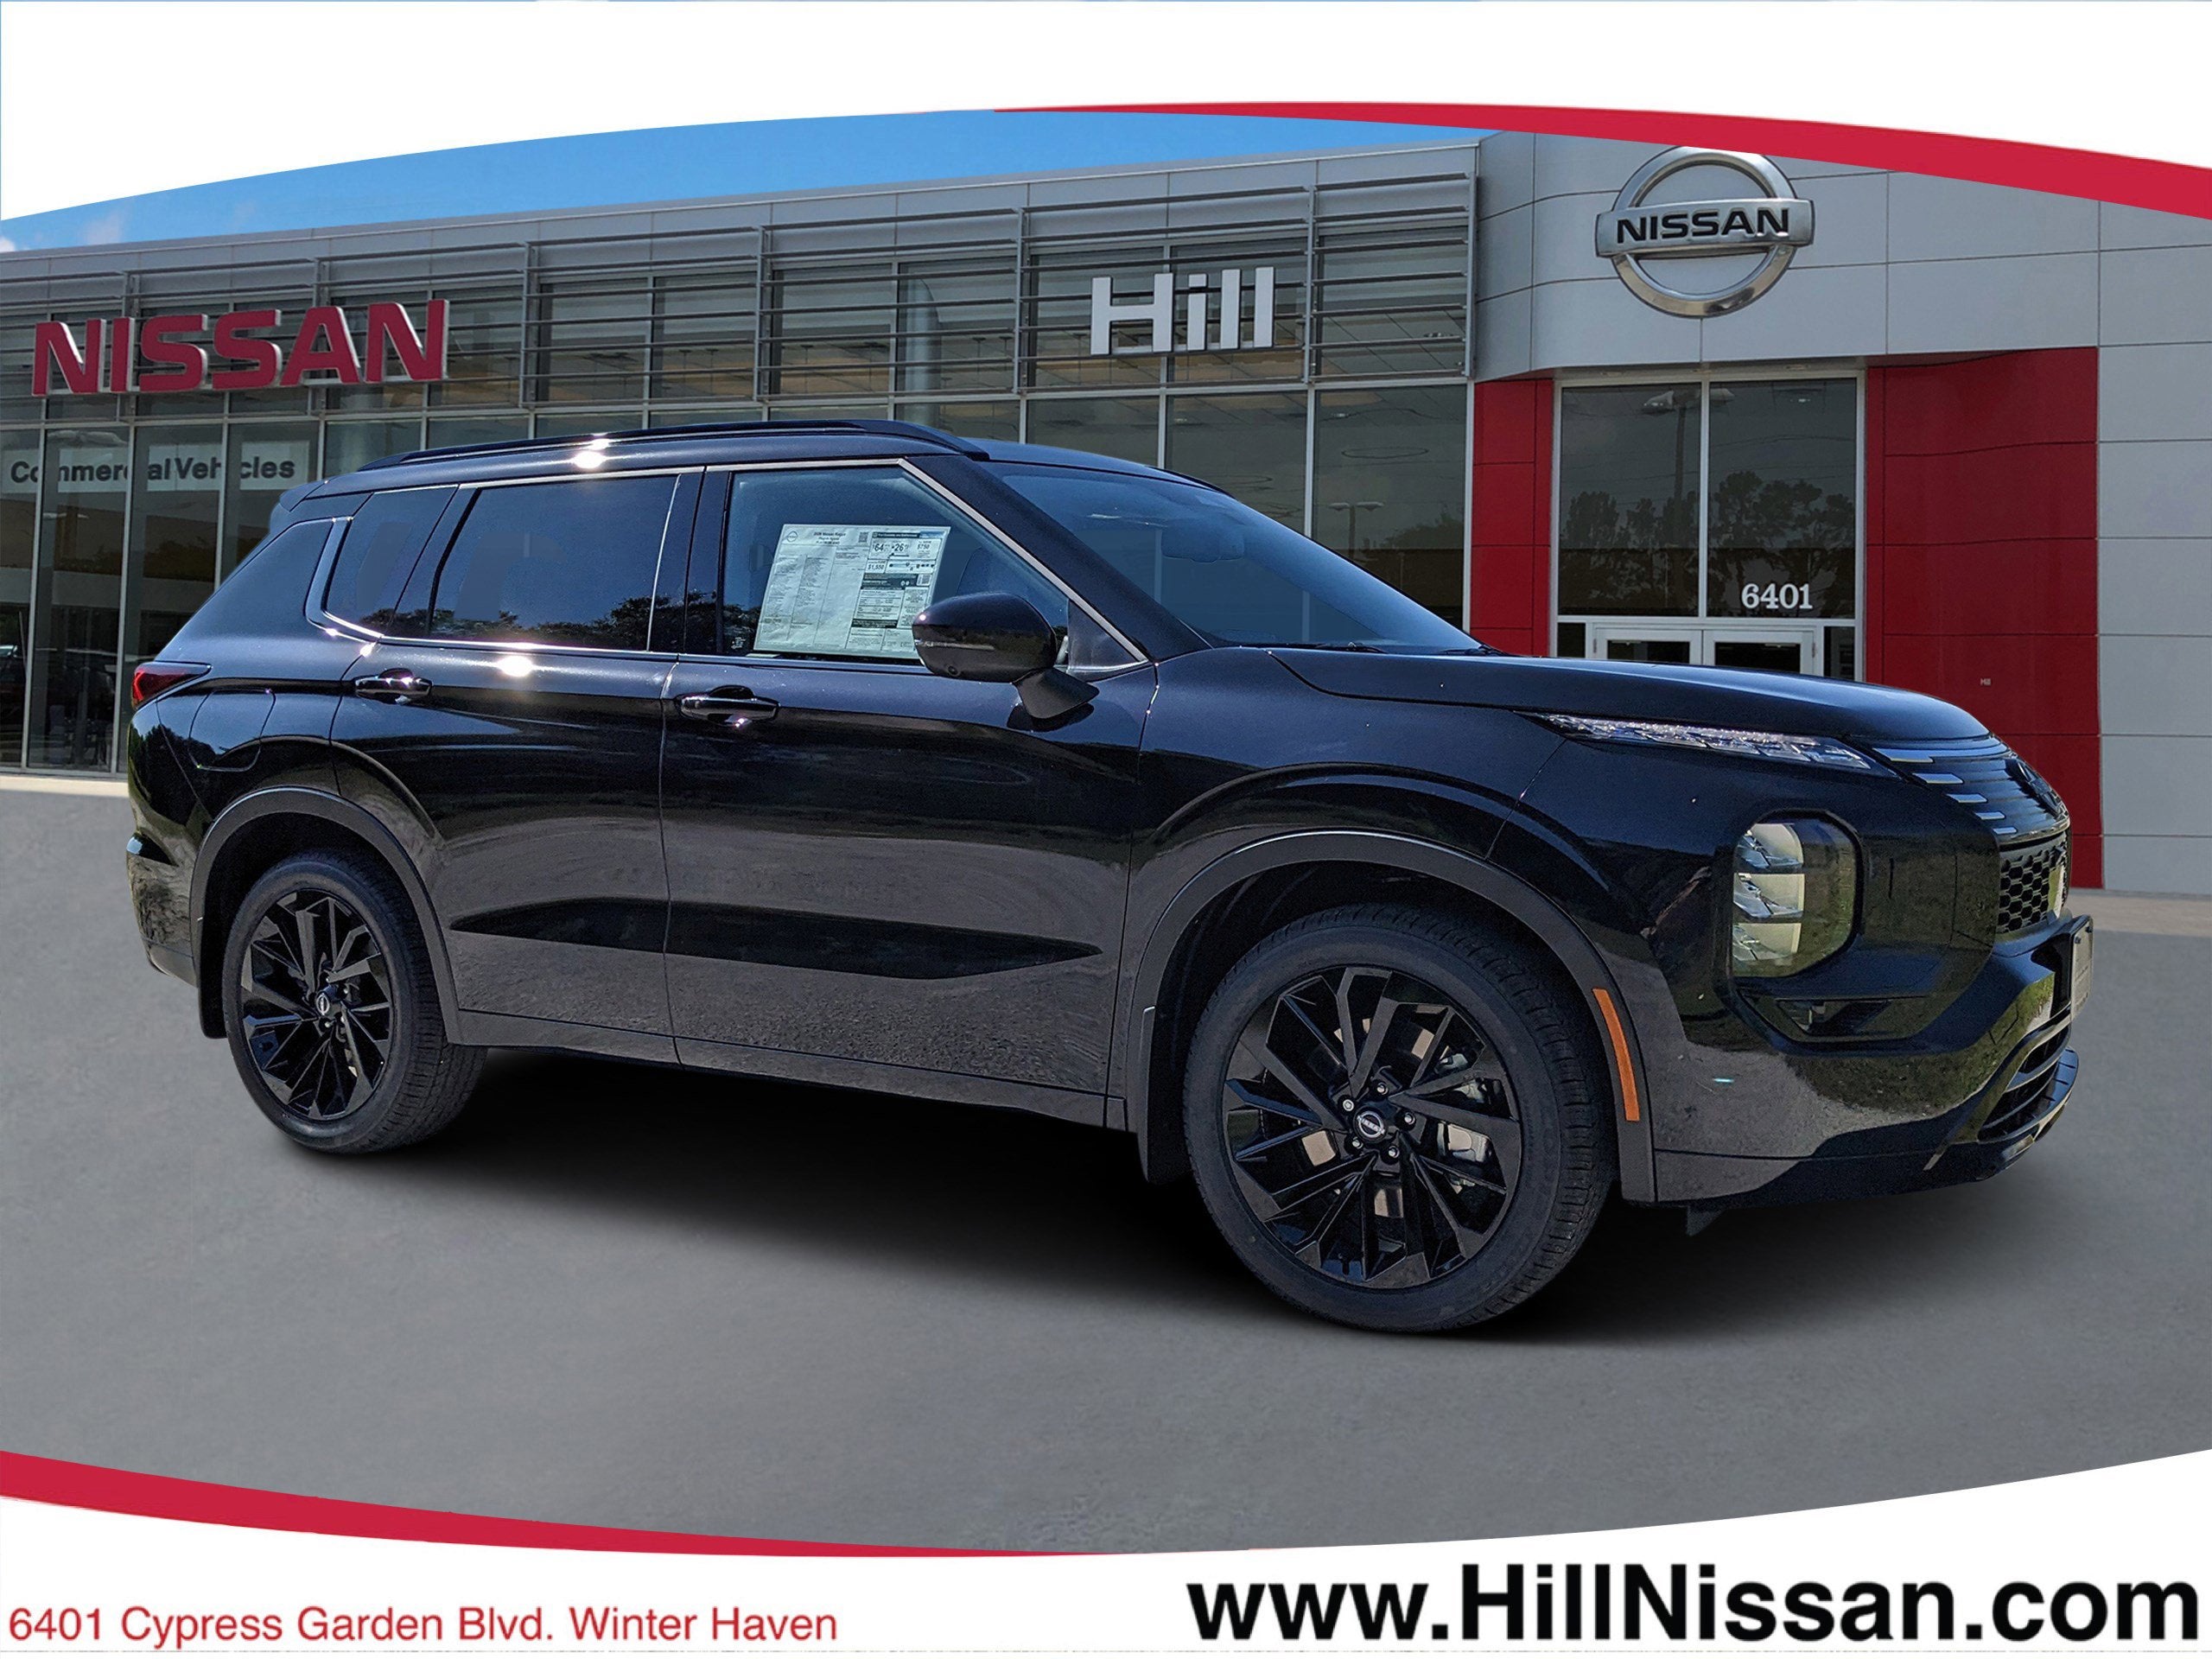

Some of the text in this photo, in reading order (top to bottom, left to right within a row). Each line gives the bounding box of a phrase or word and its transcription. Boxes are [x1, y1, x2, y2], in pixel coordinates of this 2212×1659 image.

[1618, 208, 1789, 244] NISSAN
[1090, 266, 1274, 355] Hill
[32, 299, 449, 397] NISSAN
[10, 455, 296, 484] Commeral Vehcles
[1741, 583, 1814, 609] 6401
